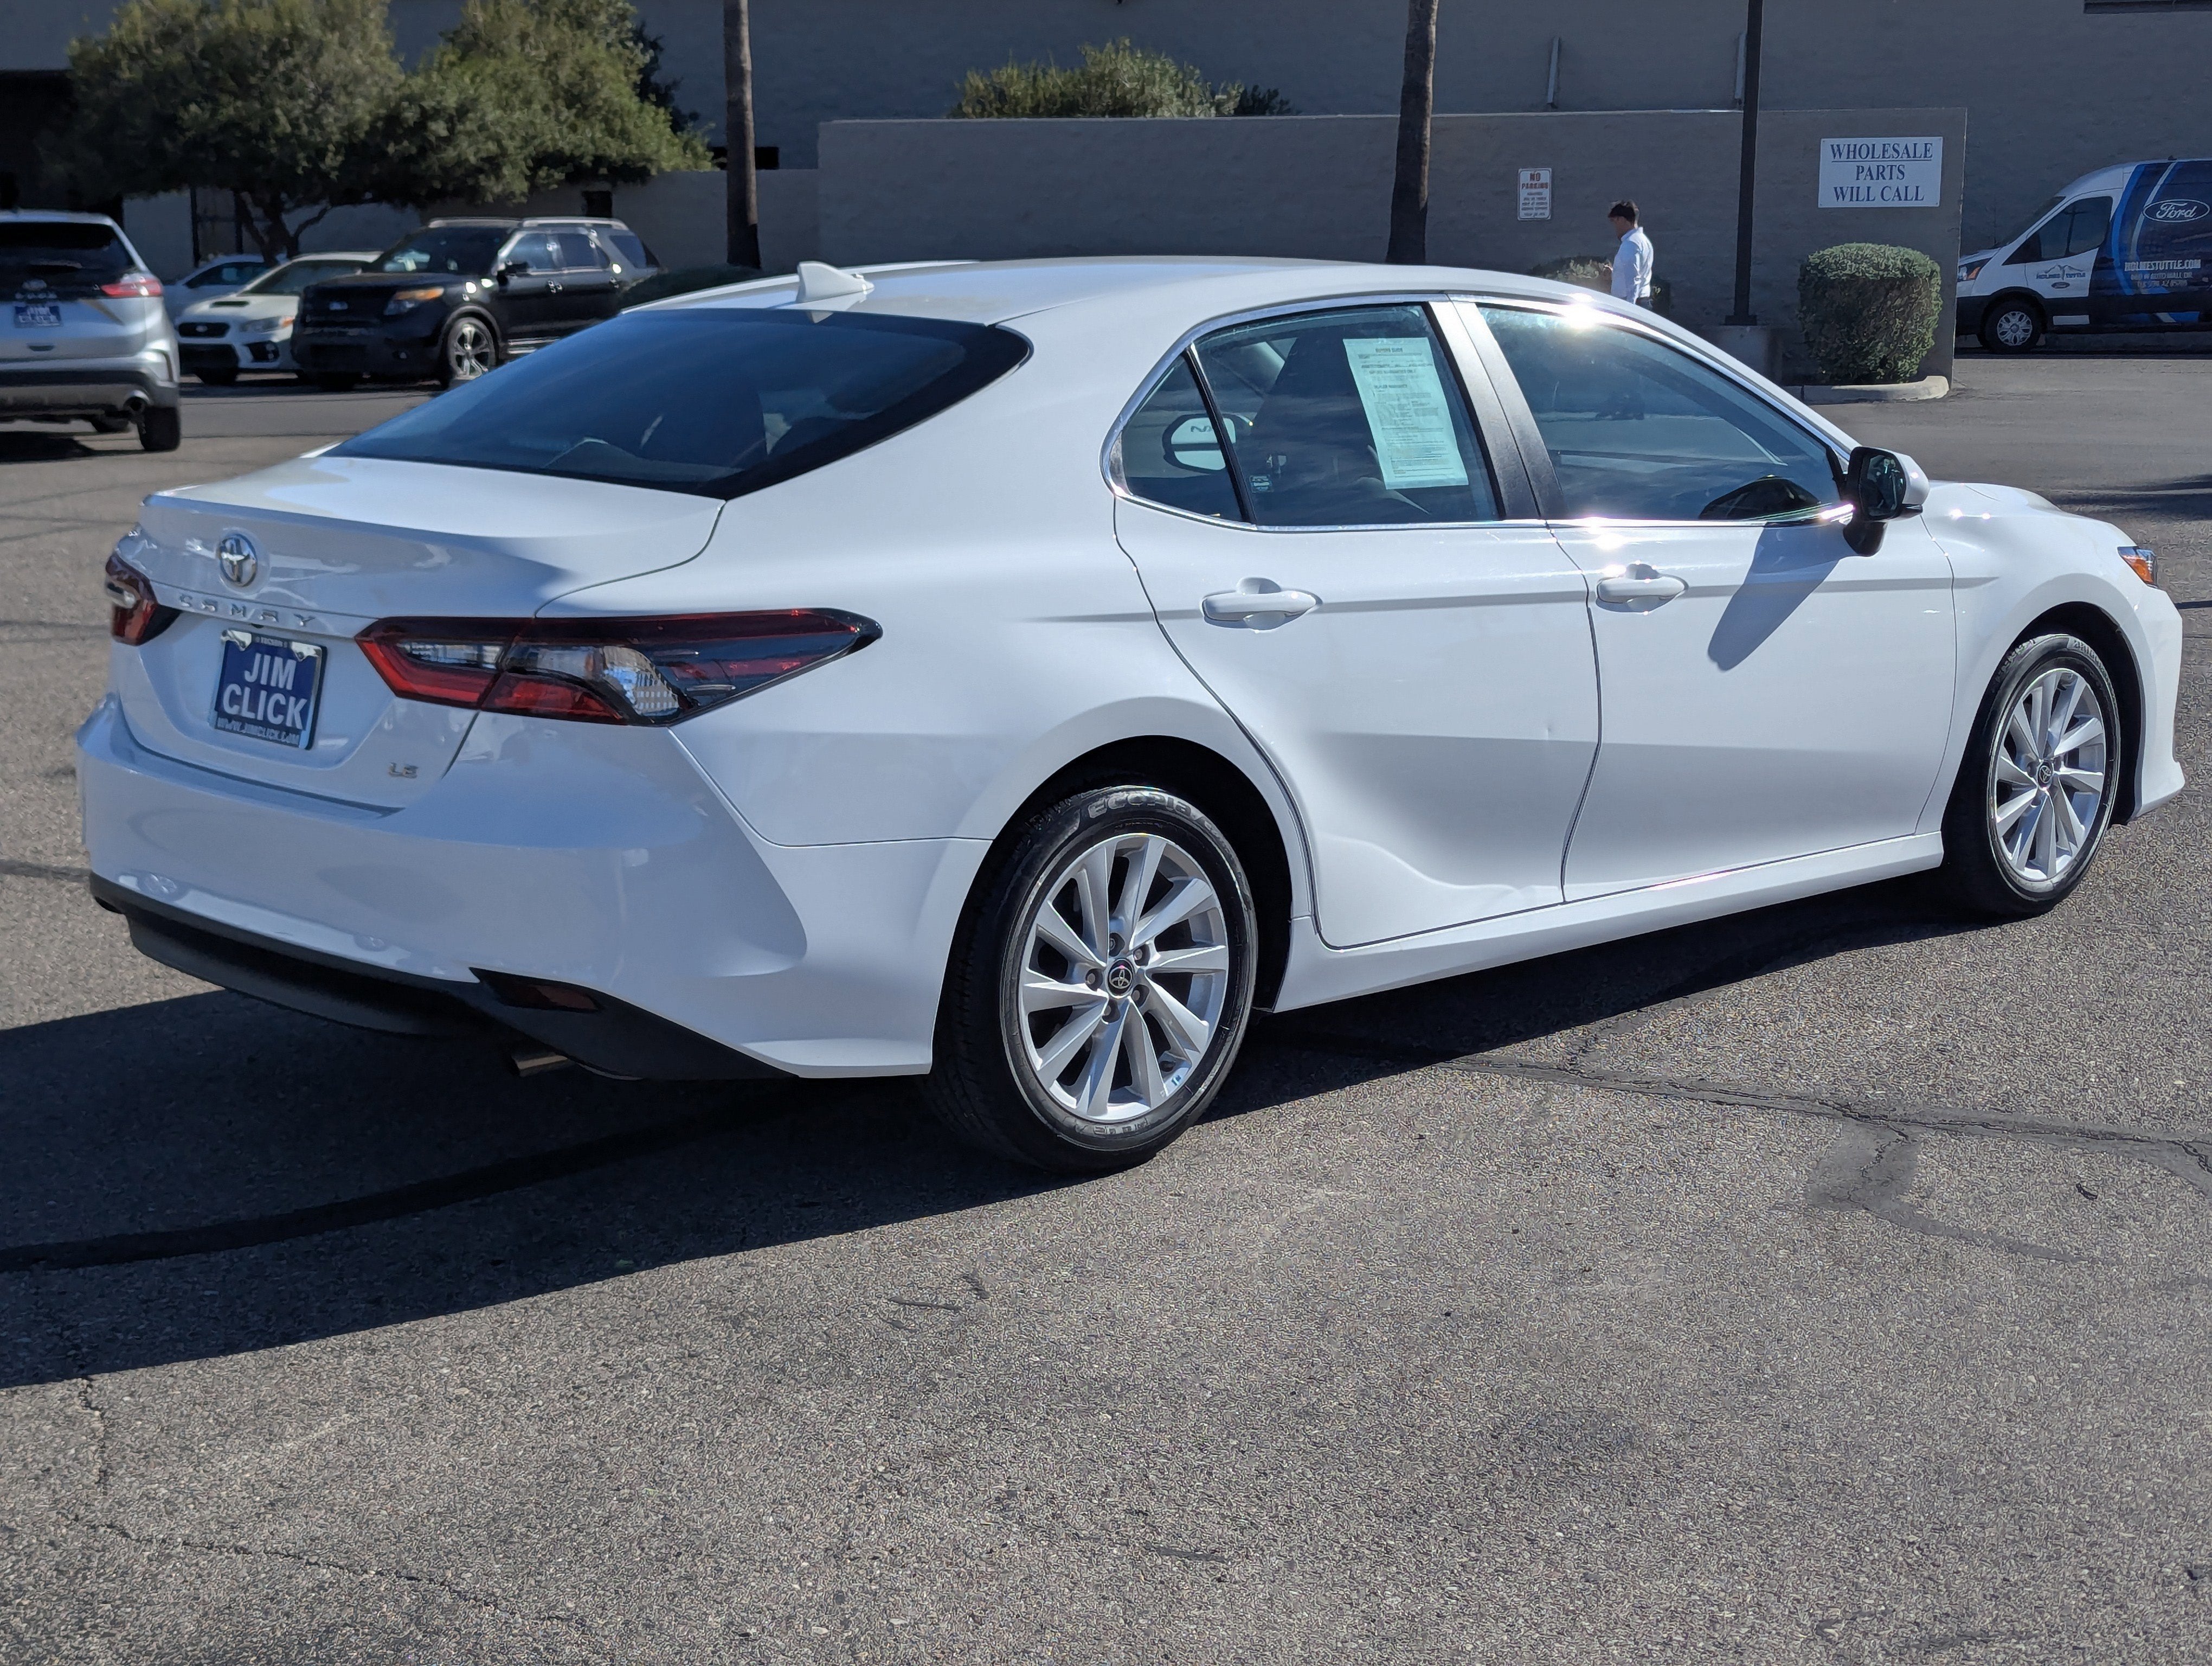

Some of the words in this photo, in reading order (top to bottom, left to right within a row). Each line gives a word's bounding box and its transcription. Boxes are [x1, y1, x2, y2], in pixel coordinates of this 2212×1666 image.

[1830, 143, 1933, 160] WHOLESALE
[1530, 172, 1541, 182] NO
[1855, 164, 1905, 180] PARTS
[1834, 186, 1875, 202] WILL
[1880, 185, 1925, 201] CALL
[2156, 202, 2198, 219] Ford
[179, 594, 316, 627] CAMRY
[245, 652, 297, 690] JIM
[223, 683, 307, 729] CLICK
[388, 762, 419, 779] LE
